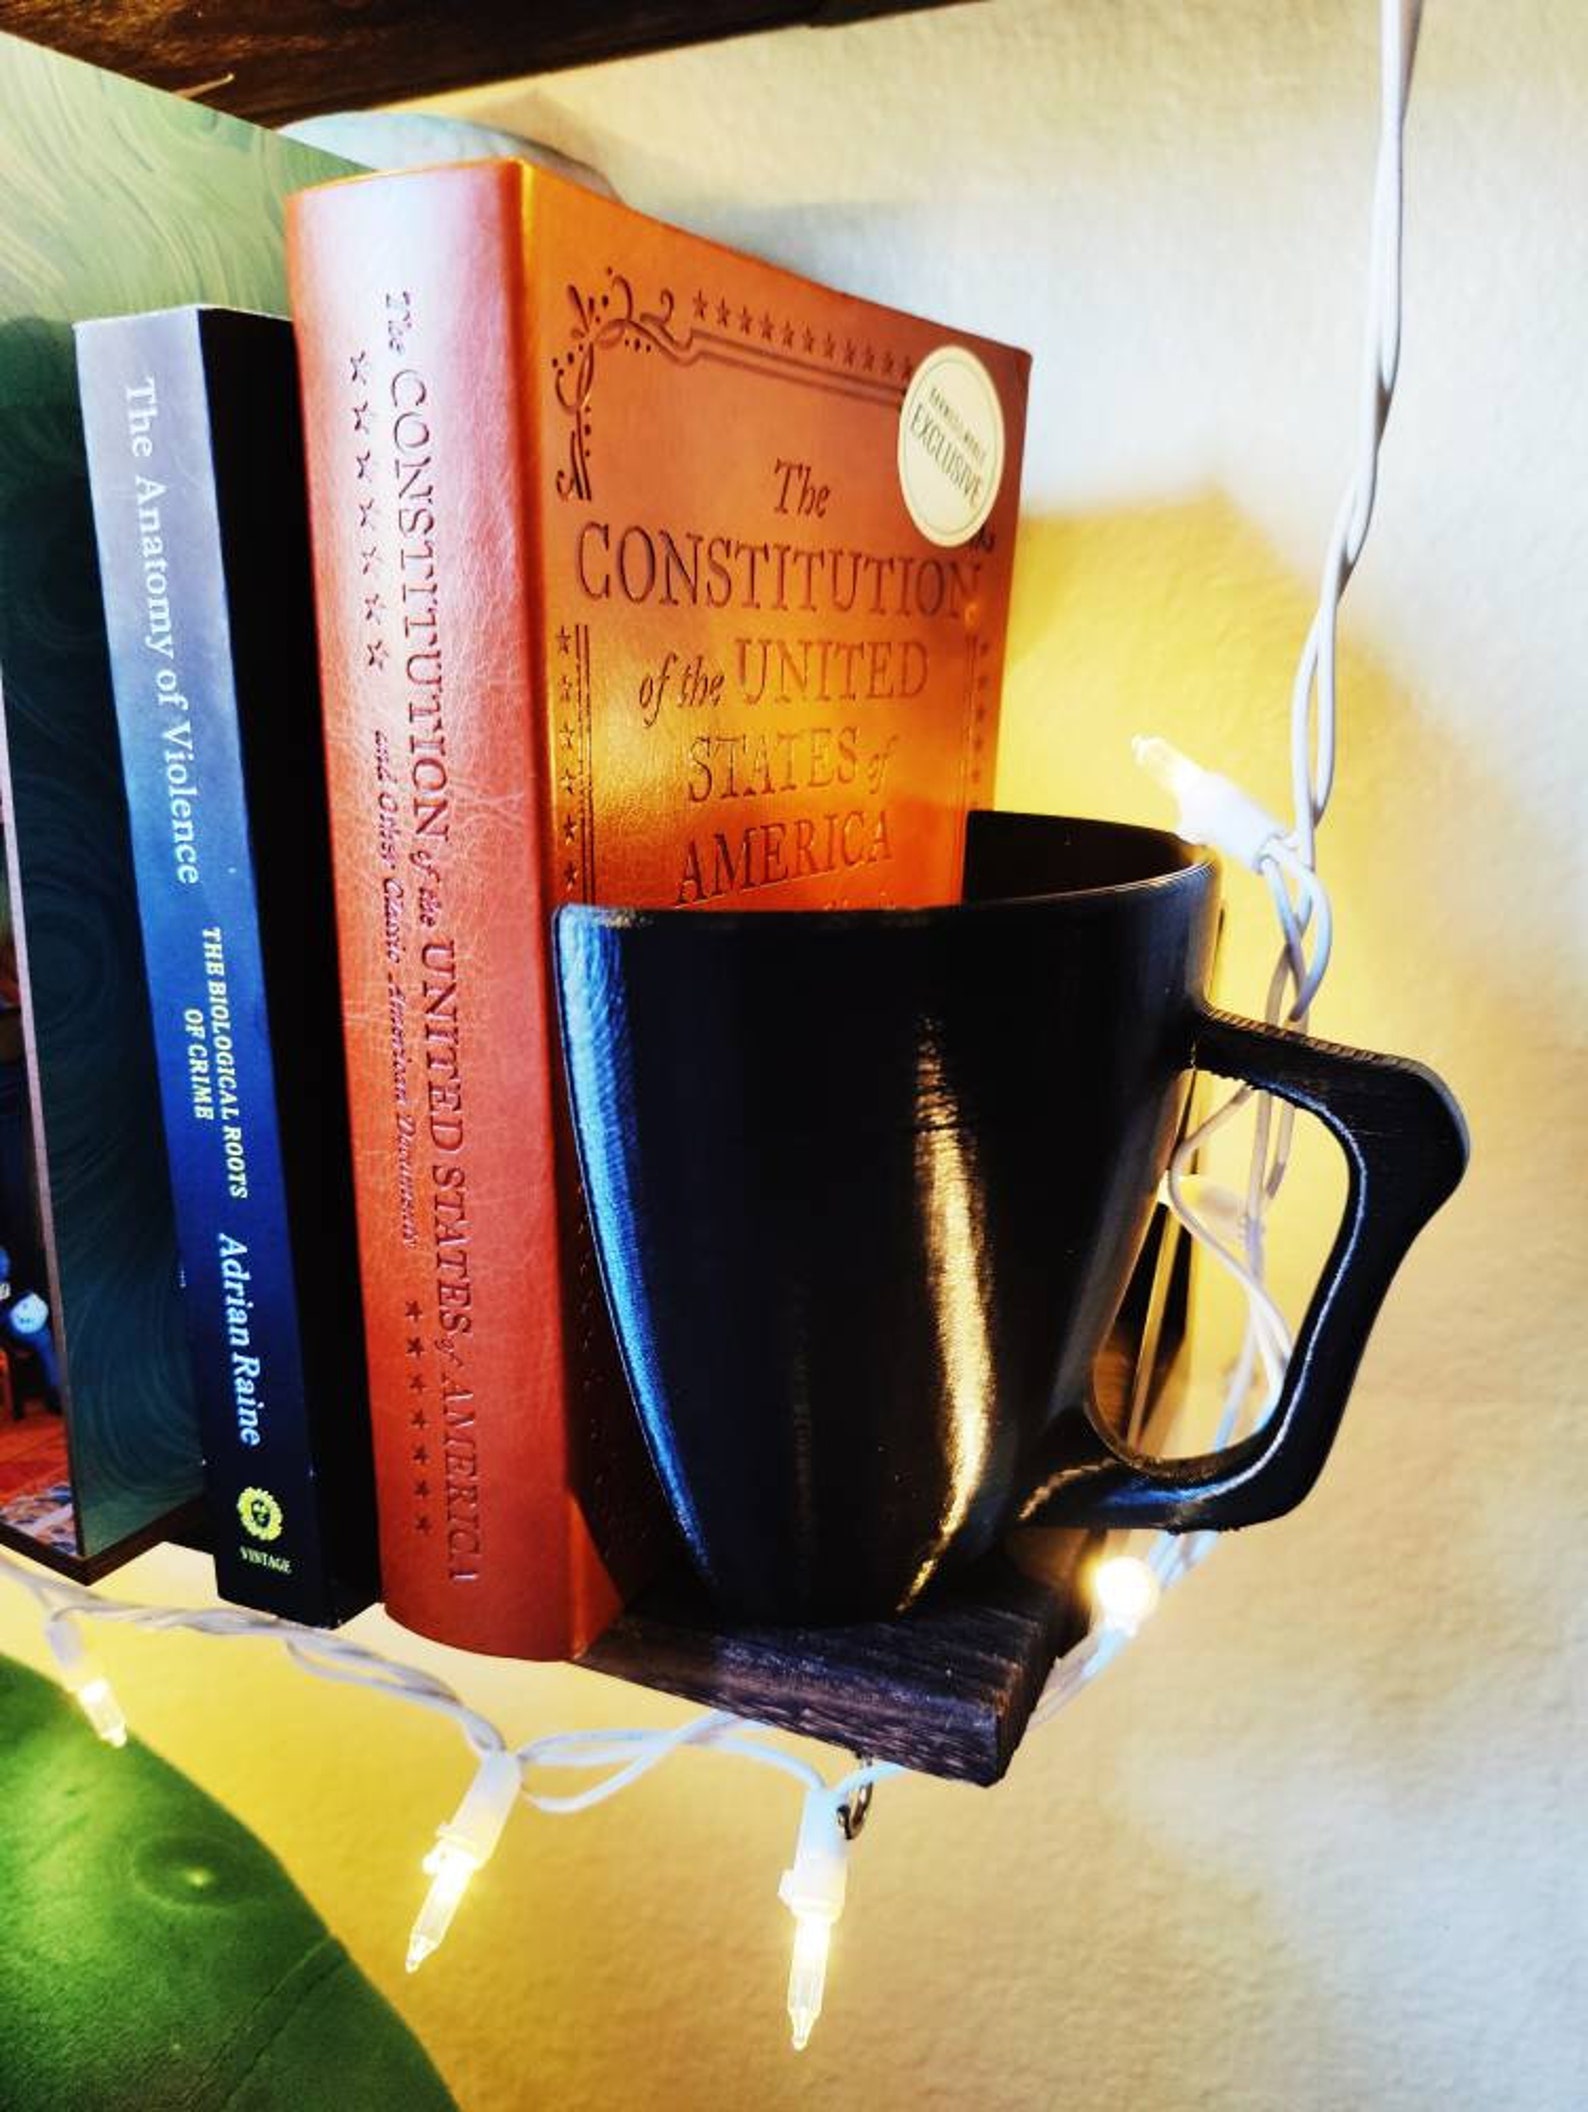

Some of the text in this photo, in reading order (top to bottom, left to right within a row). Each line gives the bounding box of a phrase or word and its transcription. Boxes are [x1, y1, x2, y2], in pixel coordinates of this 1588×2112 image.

[773, 457, 831, 520] The
[909, 403, 985, 507] EXCLUSIVE
[390, 369, 449, 842] CONSTITUTION
[577, 520, 982, 622] CONSTITUTION
[124, 376, 200, 886] The Anatomy of Violence
[639, 637, 930, 727] of the UNITED
[687, 725, 898, 803] STATES of
[409, 849, 441, 884] of
[417, 884, 443, 928] the
[676, 810, 893, 907] AMERICA
[184, 1008, 214, 1121] OF CRIME
[202, 927, 249, 1200] THE BIOLOGICAL ROOTS
[421, 940, 464, 1153] UNITED
[431, 1162, 473, 1337] STATES
[218, 1232, 265, 1447] Adrian Raine
[434, 1332, 463, 1369] of
[441, 1371, 480, 1584] AMERICA
[239, 1546, 292, 1575] VINTAGE
